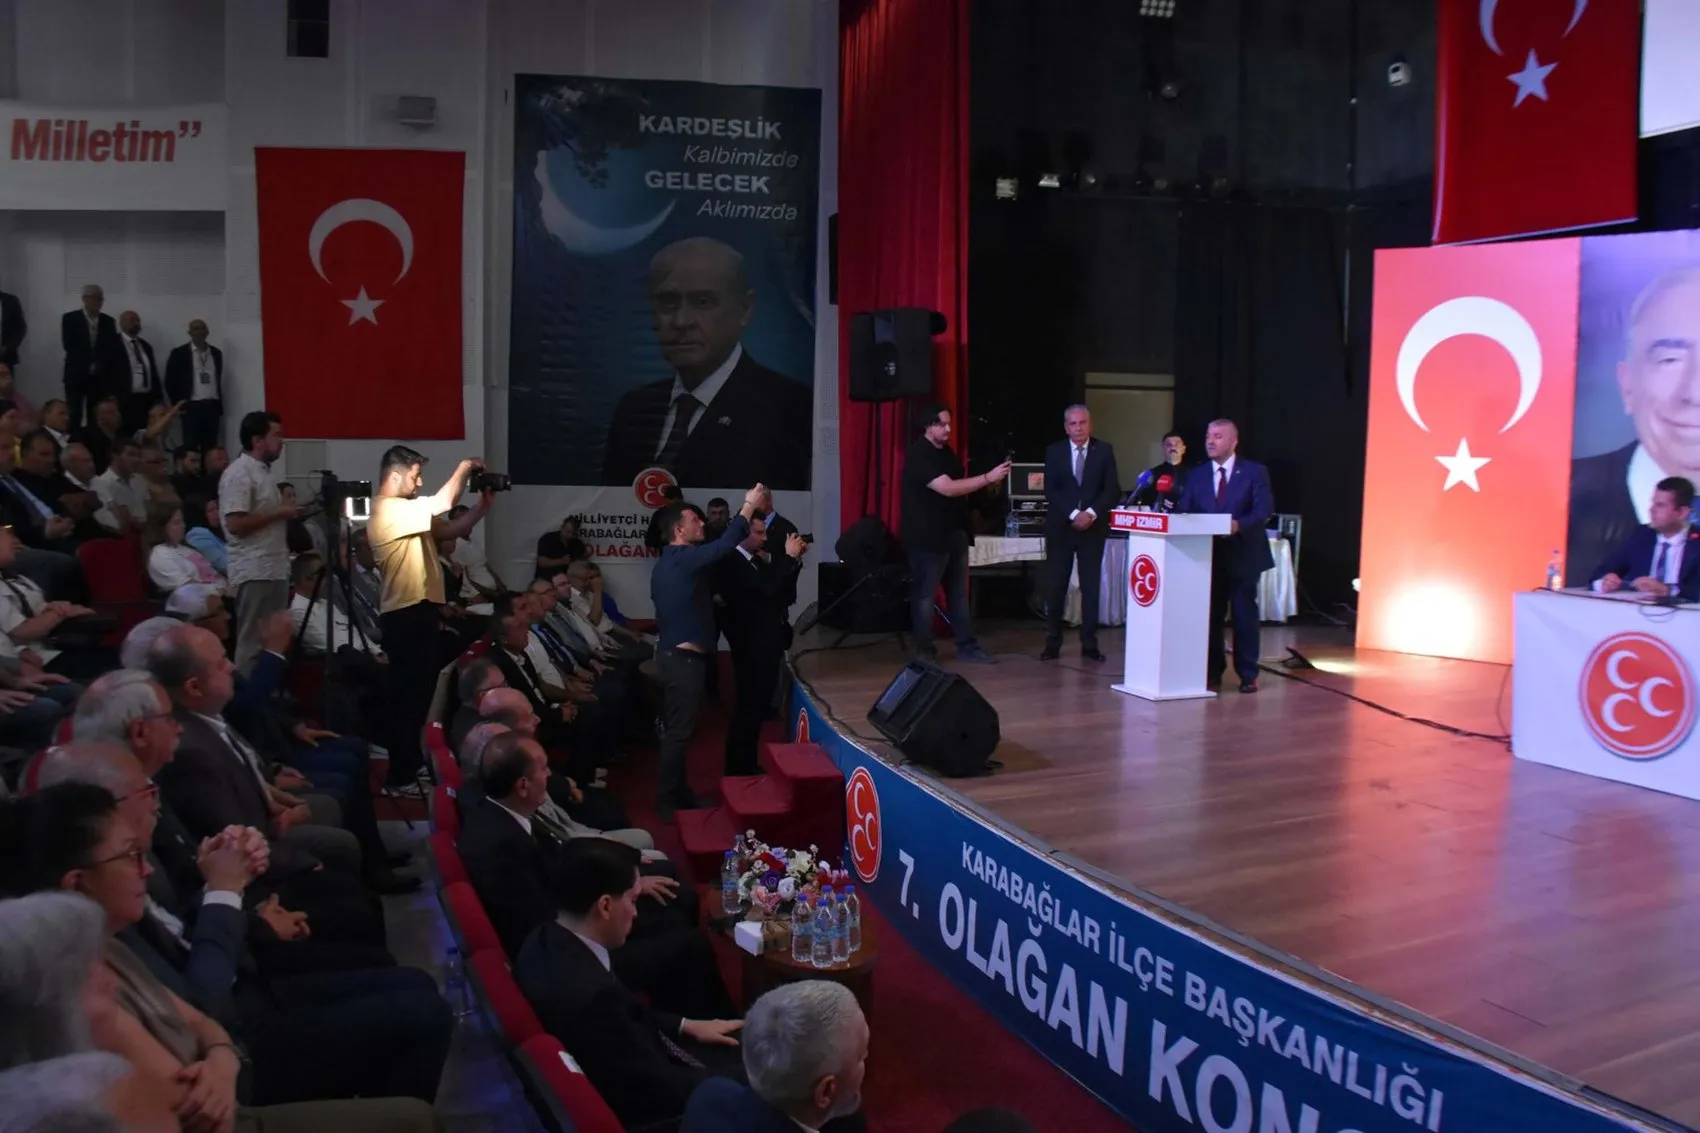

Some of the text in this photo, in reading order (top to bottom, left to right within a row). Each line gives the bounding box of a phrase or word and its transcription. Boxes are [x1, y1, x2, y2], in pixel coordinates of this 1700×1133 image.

[639, 113, 782, 140] KARDEŞLİK
[683, 144, 799, 169] Kalbimizde
[646, 170, 770, 193] GELECEK
[697, 198, 798, 221] Aklımızda
[1114, 515, 1135, 526] MHP
[580, 528, 648, 538] RABAĞLAR
[899, 848, 919, 919] 7.
[939, 882, 1128, 1077] OLAĞAN
[962, 841, 1443, 1132] KARABAĞLAR İLÇE BAŞKANLIĞI
